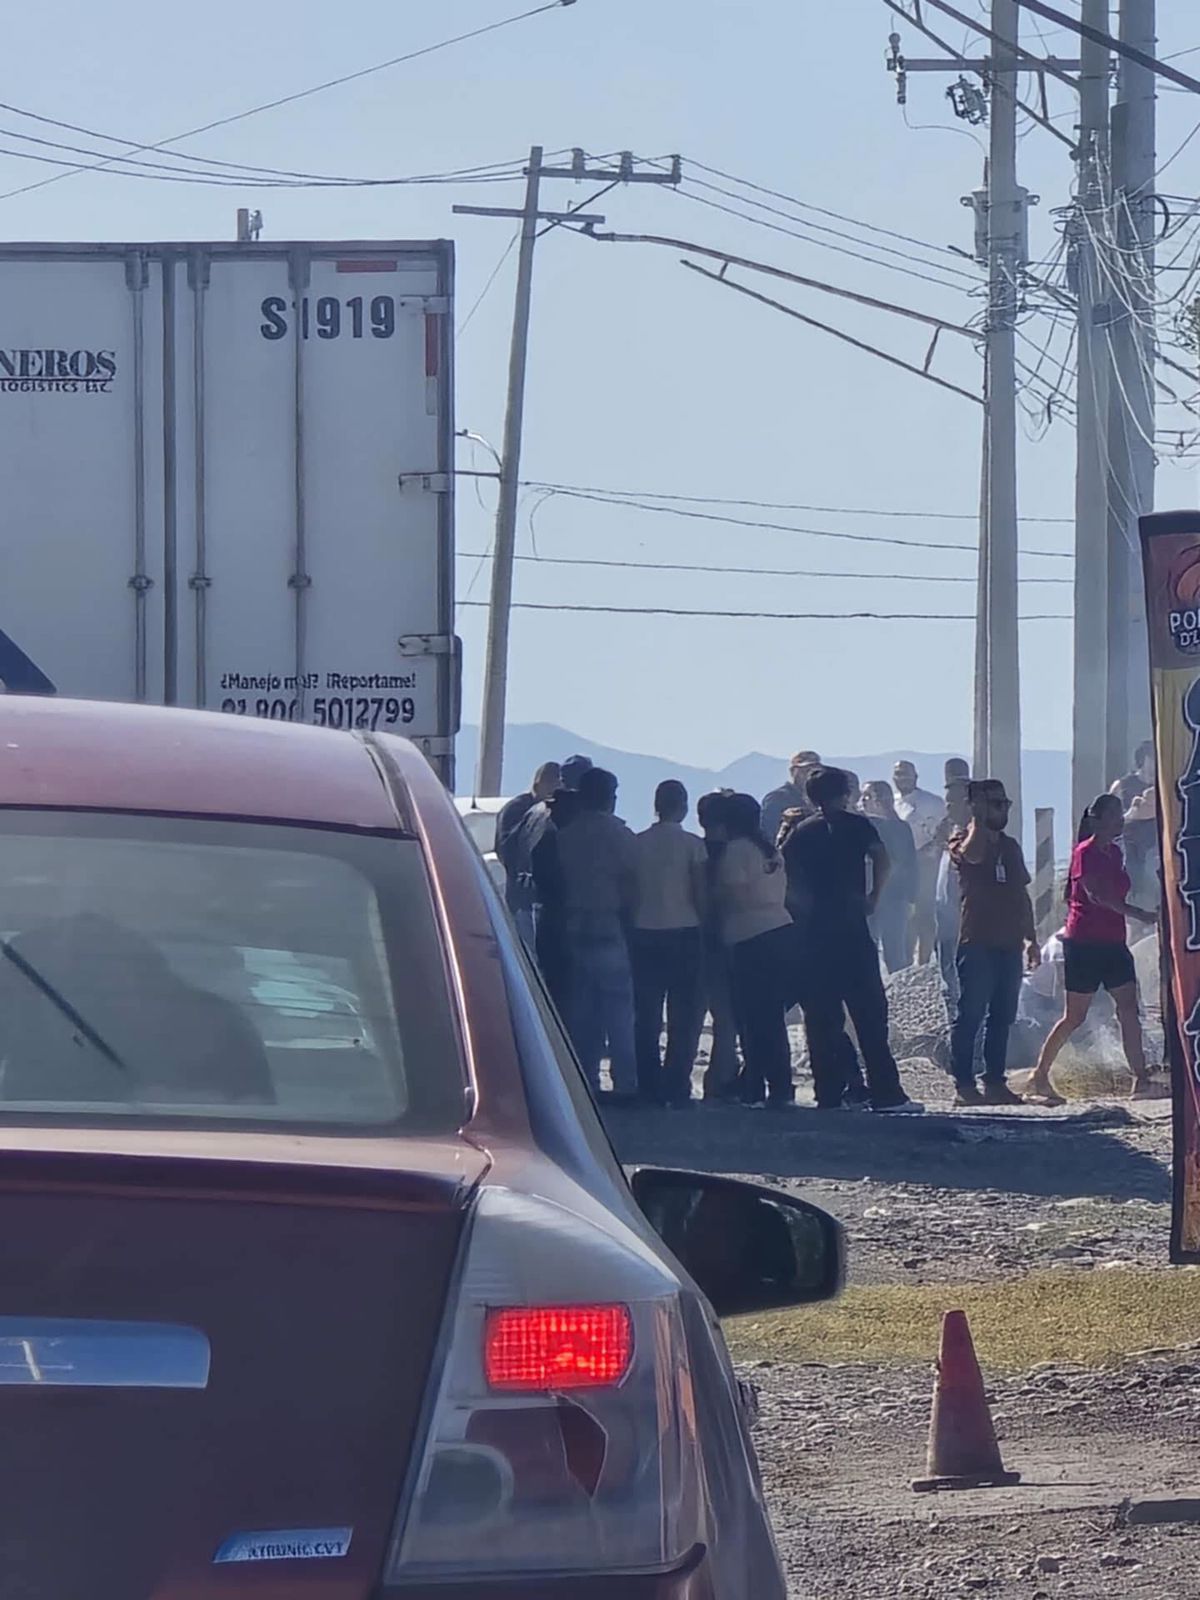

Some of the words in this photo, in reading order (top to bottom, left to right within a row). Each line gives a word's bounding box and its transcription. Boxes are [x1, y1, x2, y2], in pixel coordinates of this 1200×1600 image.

[260, 296, 395, 341] S1919
[1170, 608, 1200, 633] PO
[219, 673, 281, 691] ¿Manejo
[314, 697, 415, 732] 5012799
